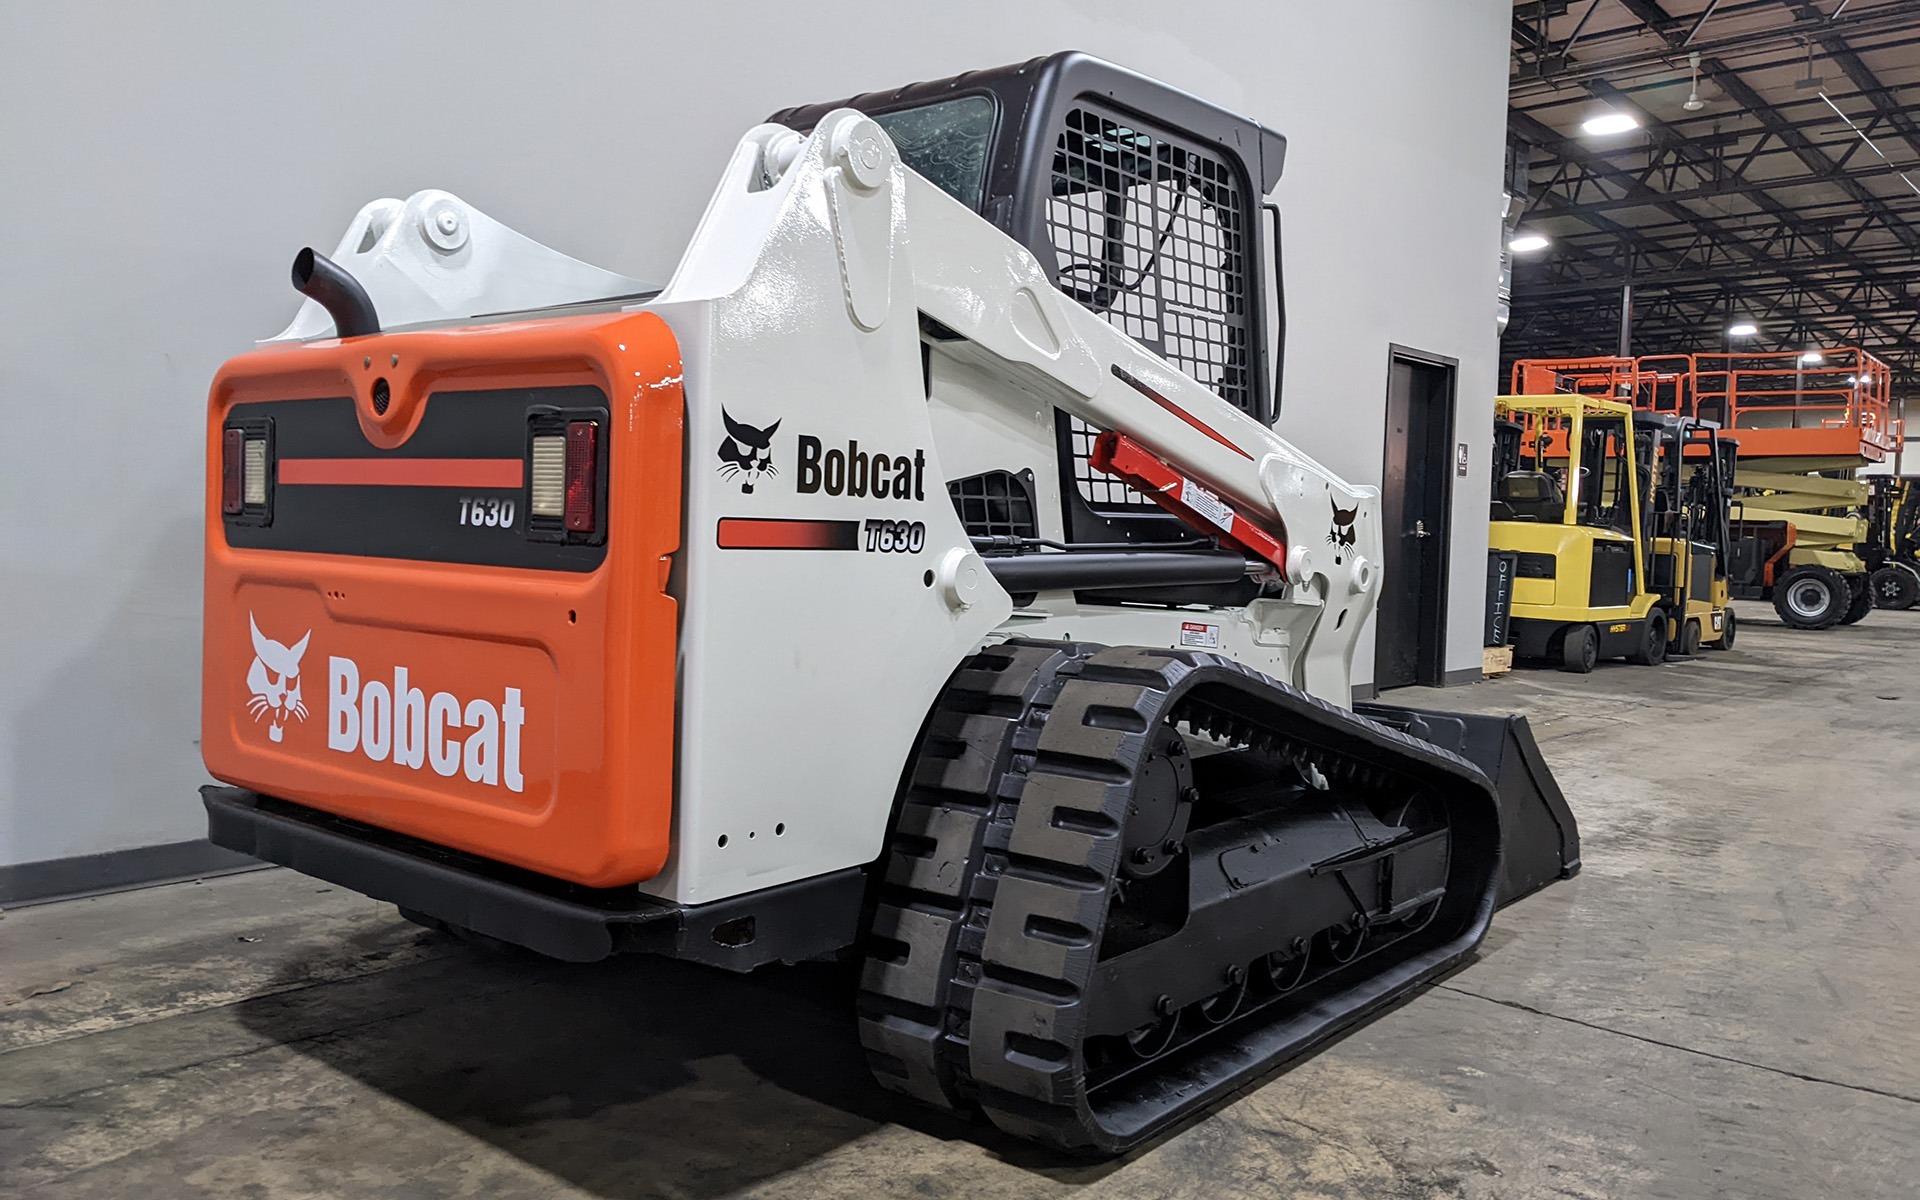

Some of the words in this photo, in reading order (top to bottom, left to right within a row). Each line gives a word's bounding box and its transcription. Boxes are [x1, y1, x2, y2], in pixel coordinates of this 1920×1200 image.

[797, 434, 926, 502] Bobcat
[1649, 446, 1659, 504] HYSTER
[459, 497, 515, 528] T630
[864, 519, 926, 554] T630
[1493, 561, 1507, 644] OFFICE
[328, 656, 525, 793] Bobcat
